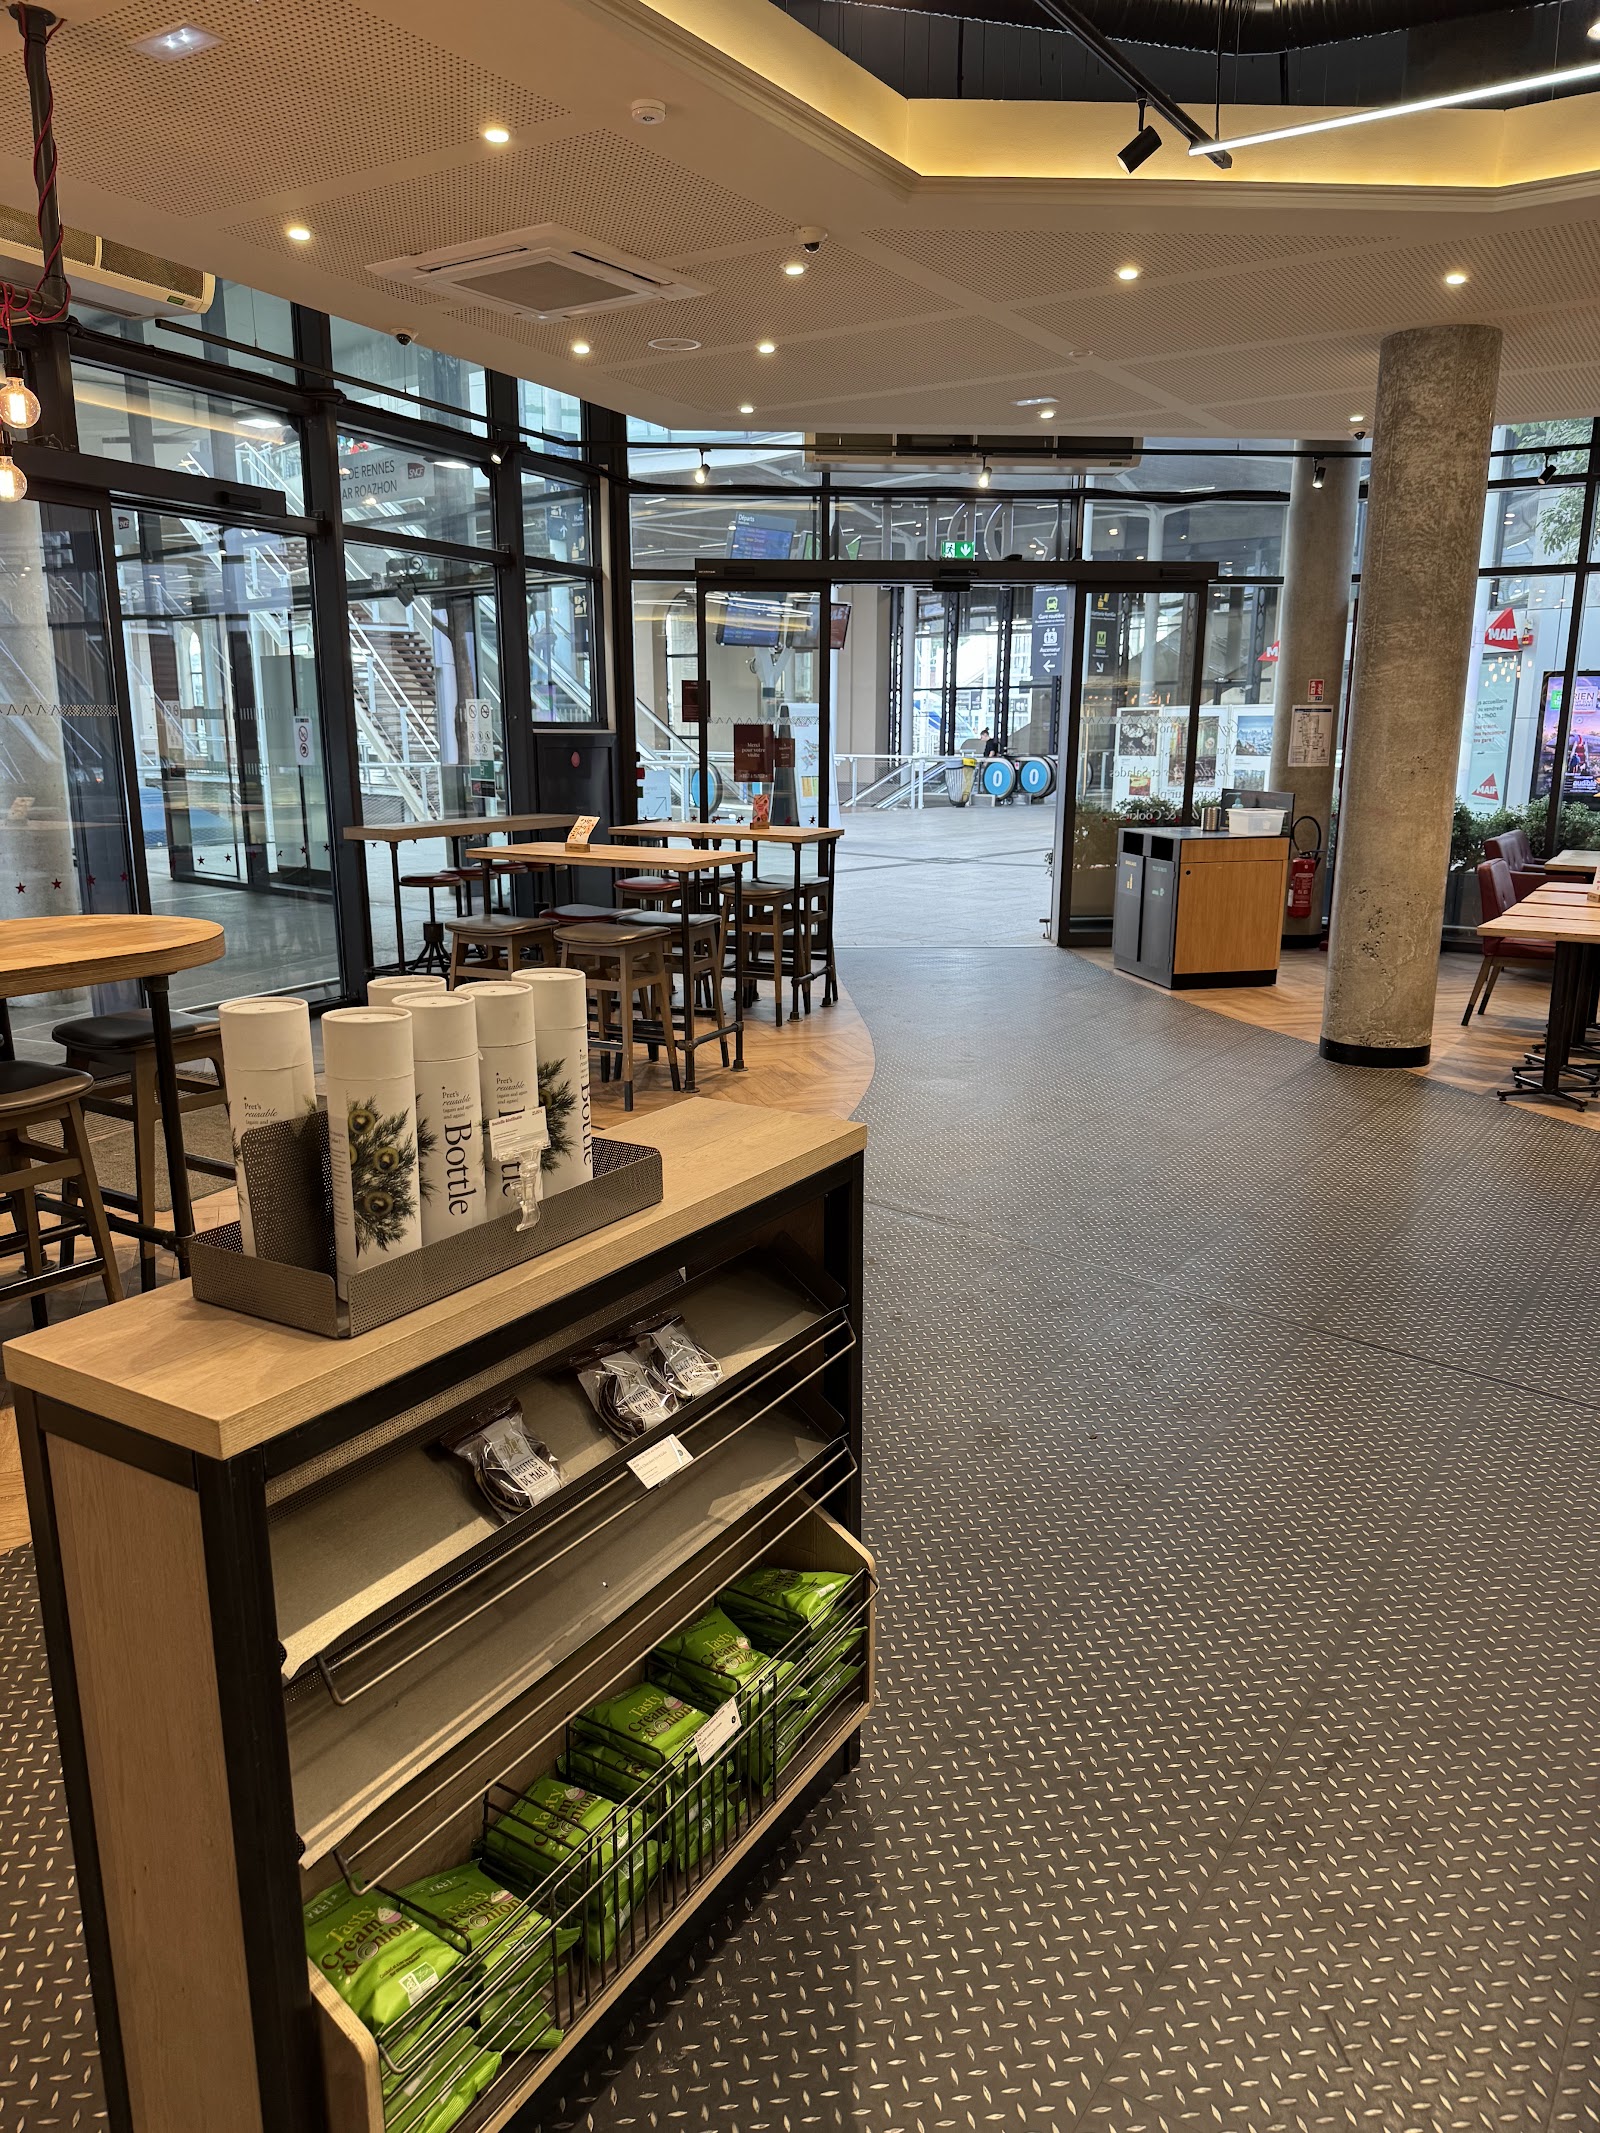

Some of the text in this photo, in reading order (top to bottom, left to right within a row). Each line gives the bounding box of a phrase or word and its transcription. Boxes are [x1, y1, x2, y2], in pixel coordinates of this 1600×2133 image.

[361, 460, 395, 478] RENNES
[408, 466, 425, 478] SNCF
[342, 480, 398, 500] AR ROAZHON
[738, 513, 755, 522] Départs
[1488, 627, 1517, 641] MAIF
[993, 770, 1003, 787] 0
[1029, 768, 1039, 785] 0
[1476, 785, 1498, 795] MAIF
[496, 1077, 513, 1085] Pret's
[496, 1080, 525, 1092] reusable
[442, 1091, 460, 1099] Pret's
[442, 1094, 472, 1107] reusable
[244, 1102, 262, 1110] Pret's
[244, 1108, 278, 1118] reusable
[444, 1120, 477, 1216] Bottle
[634, 1404, 645, 1414] DE
[510, 1458, 539, 1477] GALETTES
[519, 1475, 533, 1486] DE
[703, 1631, 736, 1650] Tasty
[701, 1642, 741, 1666] Cream
[629, 1693, 664, 1717] Tasty
[628, 1705, 671, 1733] Cream
[442, 1890, 489, 1915] Tasty
[325, 1907, 376, 1943] Tasty
[321, 1919, 385, 1971] Cream
[342, 1919, 414, 1977] & Onion
